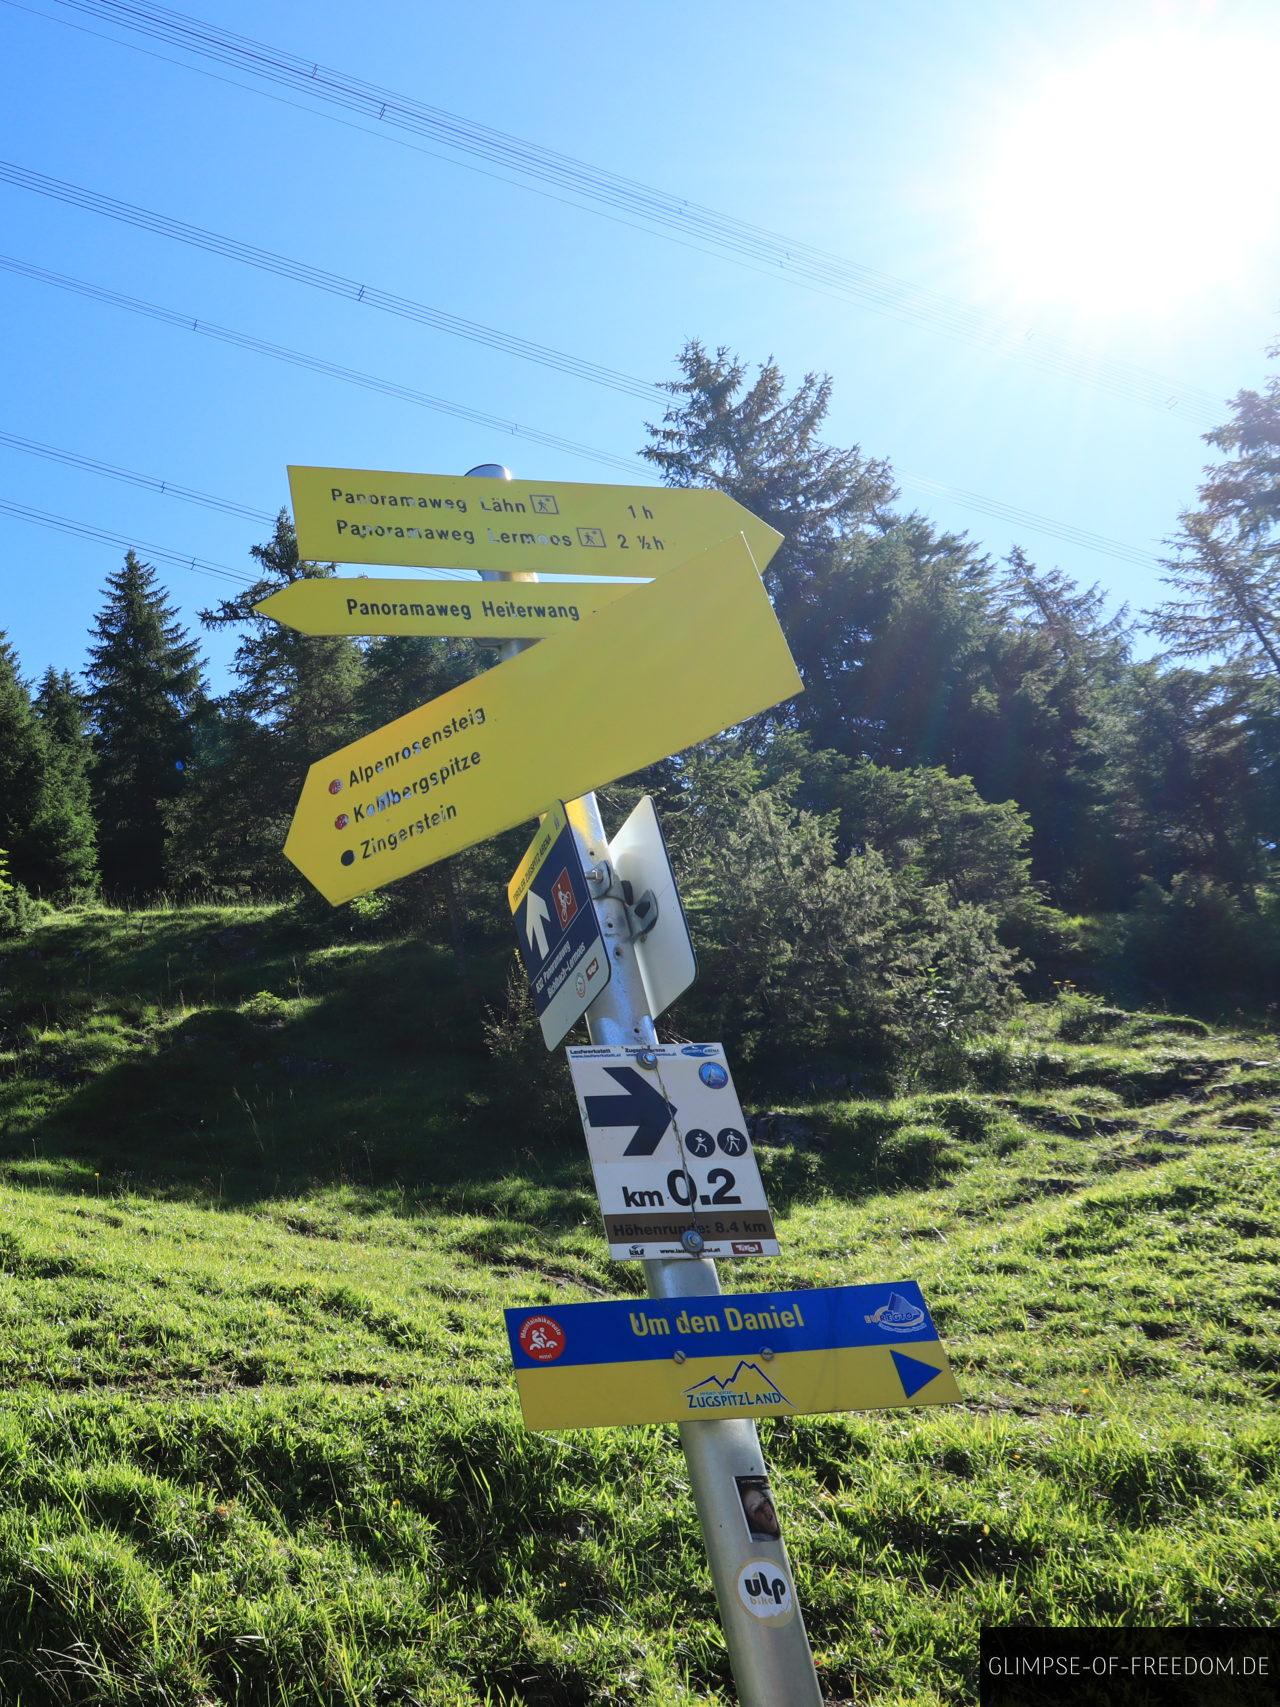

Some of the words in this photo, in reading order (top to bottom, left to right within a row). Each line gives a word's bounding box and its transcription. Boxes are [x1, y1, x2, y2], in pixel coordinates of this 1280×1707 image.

[331, 488, 467, 513] Panoramaweg
[479, 496, 526, 513] Lähn
[627, 504, 637, 519] 1
[642, 505, 654, 520] h
[336, 519, 475, 544] Panoramaweg
[487, 527, 572, 547] Lermoos
[617, 534, 630, 549] 2
[346, 598, 472, 620] Panoramaweg
[481, 600, 580, 622] Heiterwang
[349, 707, 486, 788] Alpenrosensteig
[353, 752, 481, 823] Kohlbergspitze
[360, 805, 457, 859] Zingerstein
[622, 1186, 664, 1207] km
[667, 1168, 742, 1207] 0.2
[715, 1221, 740, 1234] 8.4
[743, 1220, 767, 1233] km
[629, 1312, 670, 1336] Um
[676, 1310, 720, 1334] den
[724, 1304, 805, 1331] Daniel
